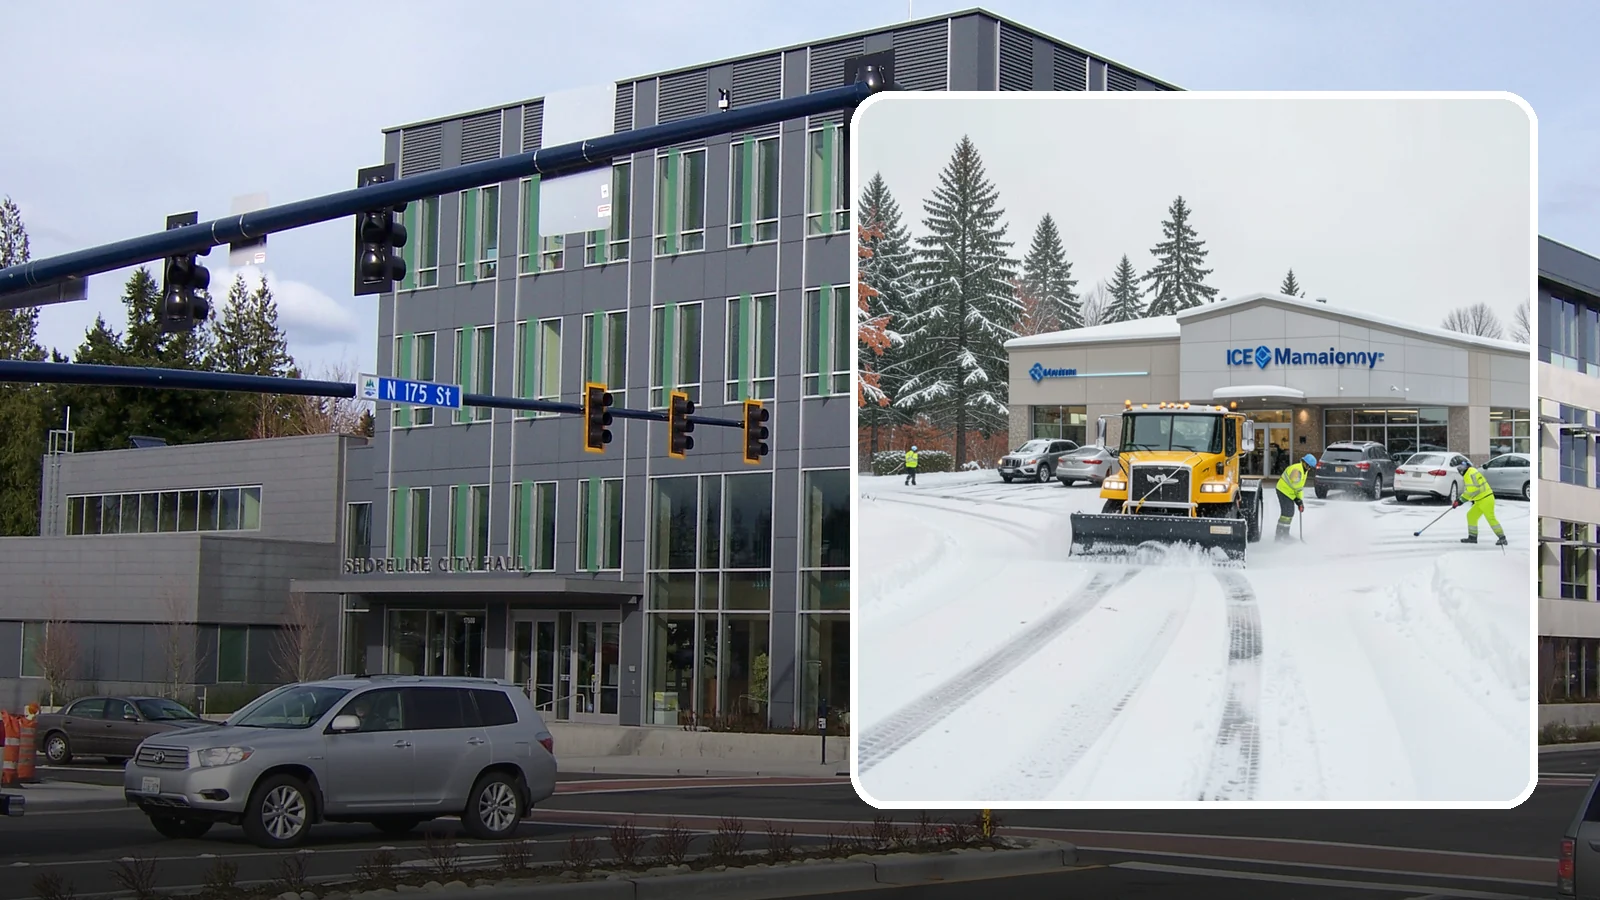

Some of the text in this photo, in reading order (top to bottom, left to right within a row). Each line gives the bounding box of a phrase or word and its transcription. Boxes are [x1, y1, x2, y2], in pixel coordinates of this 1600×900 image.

[1226, 349, 1253, 365] ICE
[387, 380, 451, 406] N 175 St
[344, 555, 525, 573] SHORELINE CITY HALL
